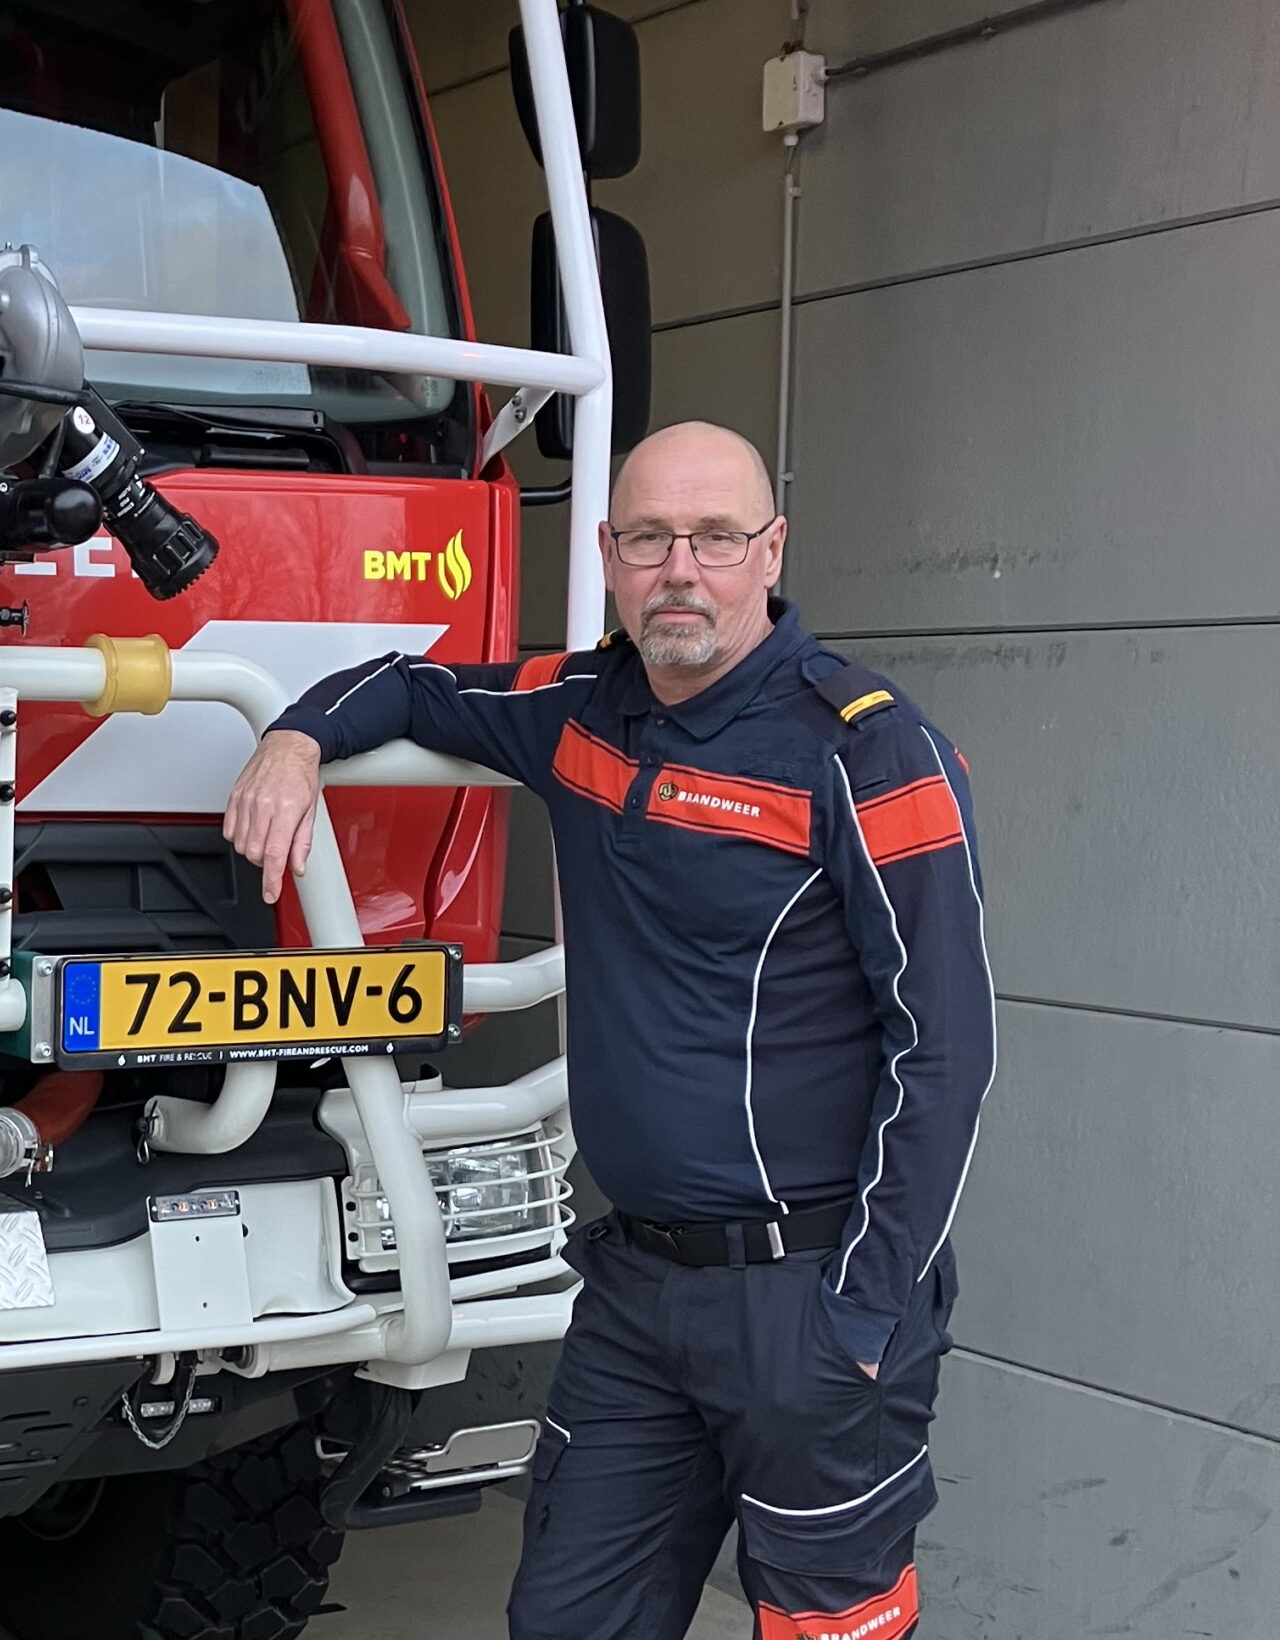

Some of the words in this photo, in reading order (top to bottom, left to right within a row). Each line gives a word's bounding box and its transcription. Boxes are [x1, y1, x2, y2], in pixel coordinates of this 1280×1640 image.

[78, 414, 91, 425] 12
[364, 550, 431, 581] BMT
[125, 964, 422, 1036] 72-BNV-6
[69, 1016, 95, 1036] NL
[137, 1054, 156, 1064] BMT
[159, 1053, 175, 1062] FIRE
[230, 1045, 369, 1059] WWW.BMT-FIREANDRESCUE.COM
